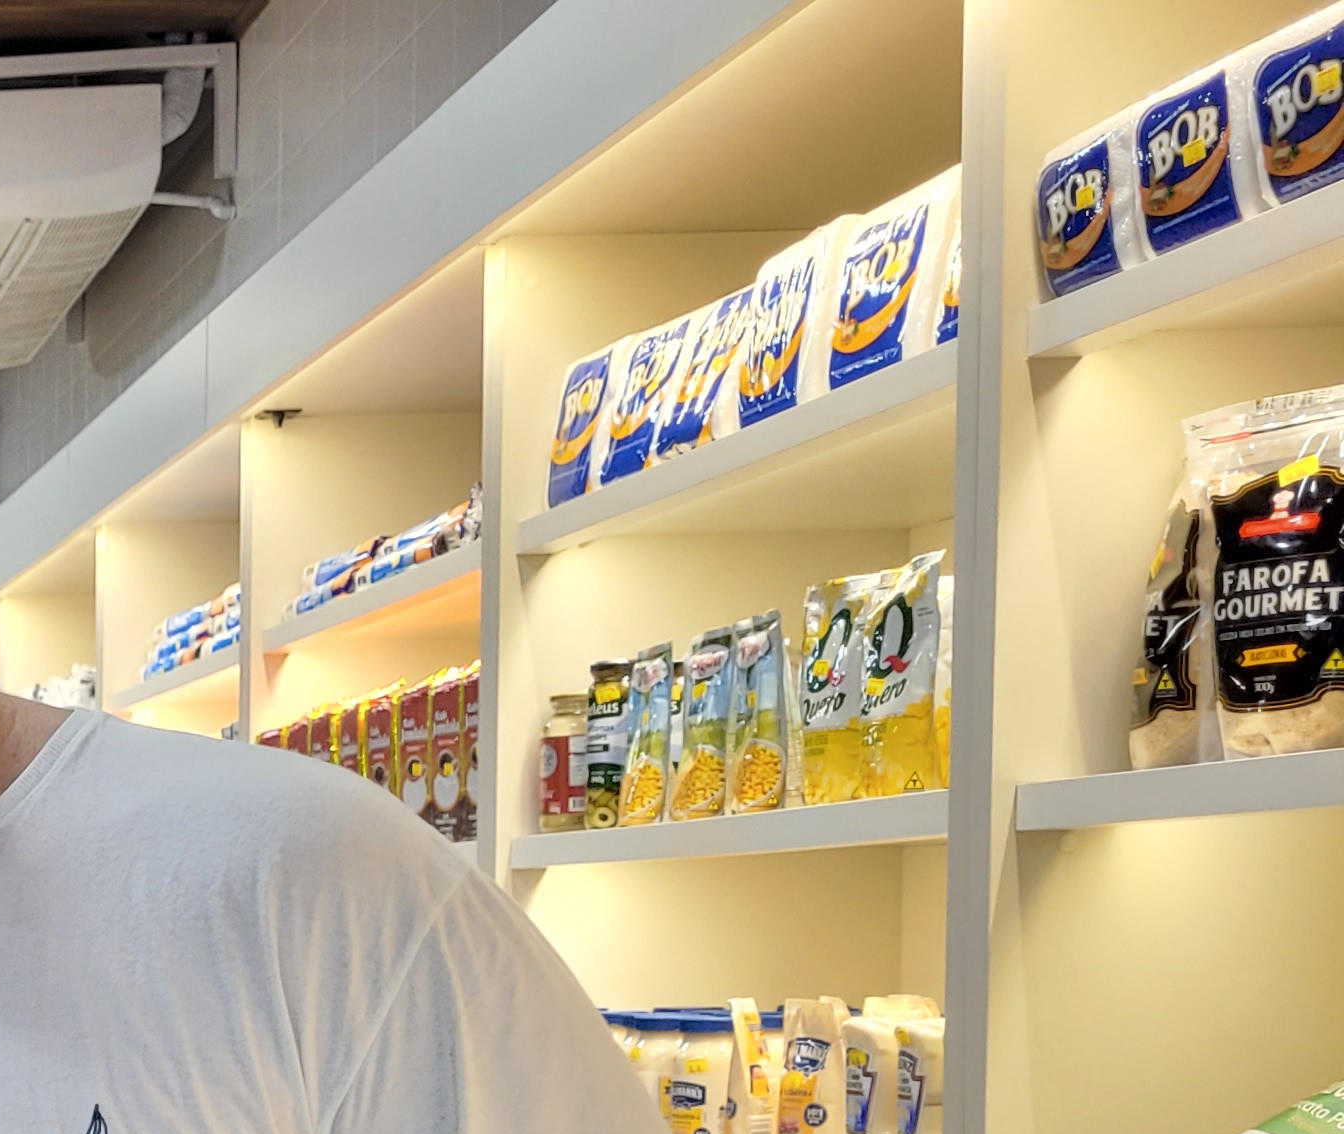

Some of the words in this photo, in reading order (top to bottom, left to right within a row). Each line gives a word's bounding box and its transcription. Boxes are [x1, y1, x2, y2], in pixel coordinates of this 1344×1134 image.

[1148, 105, 1219, 181] BOB
[1223, 559, 1330, 597] FAROFA
[1214, 586, 1344, 621] GOURMET
